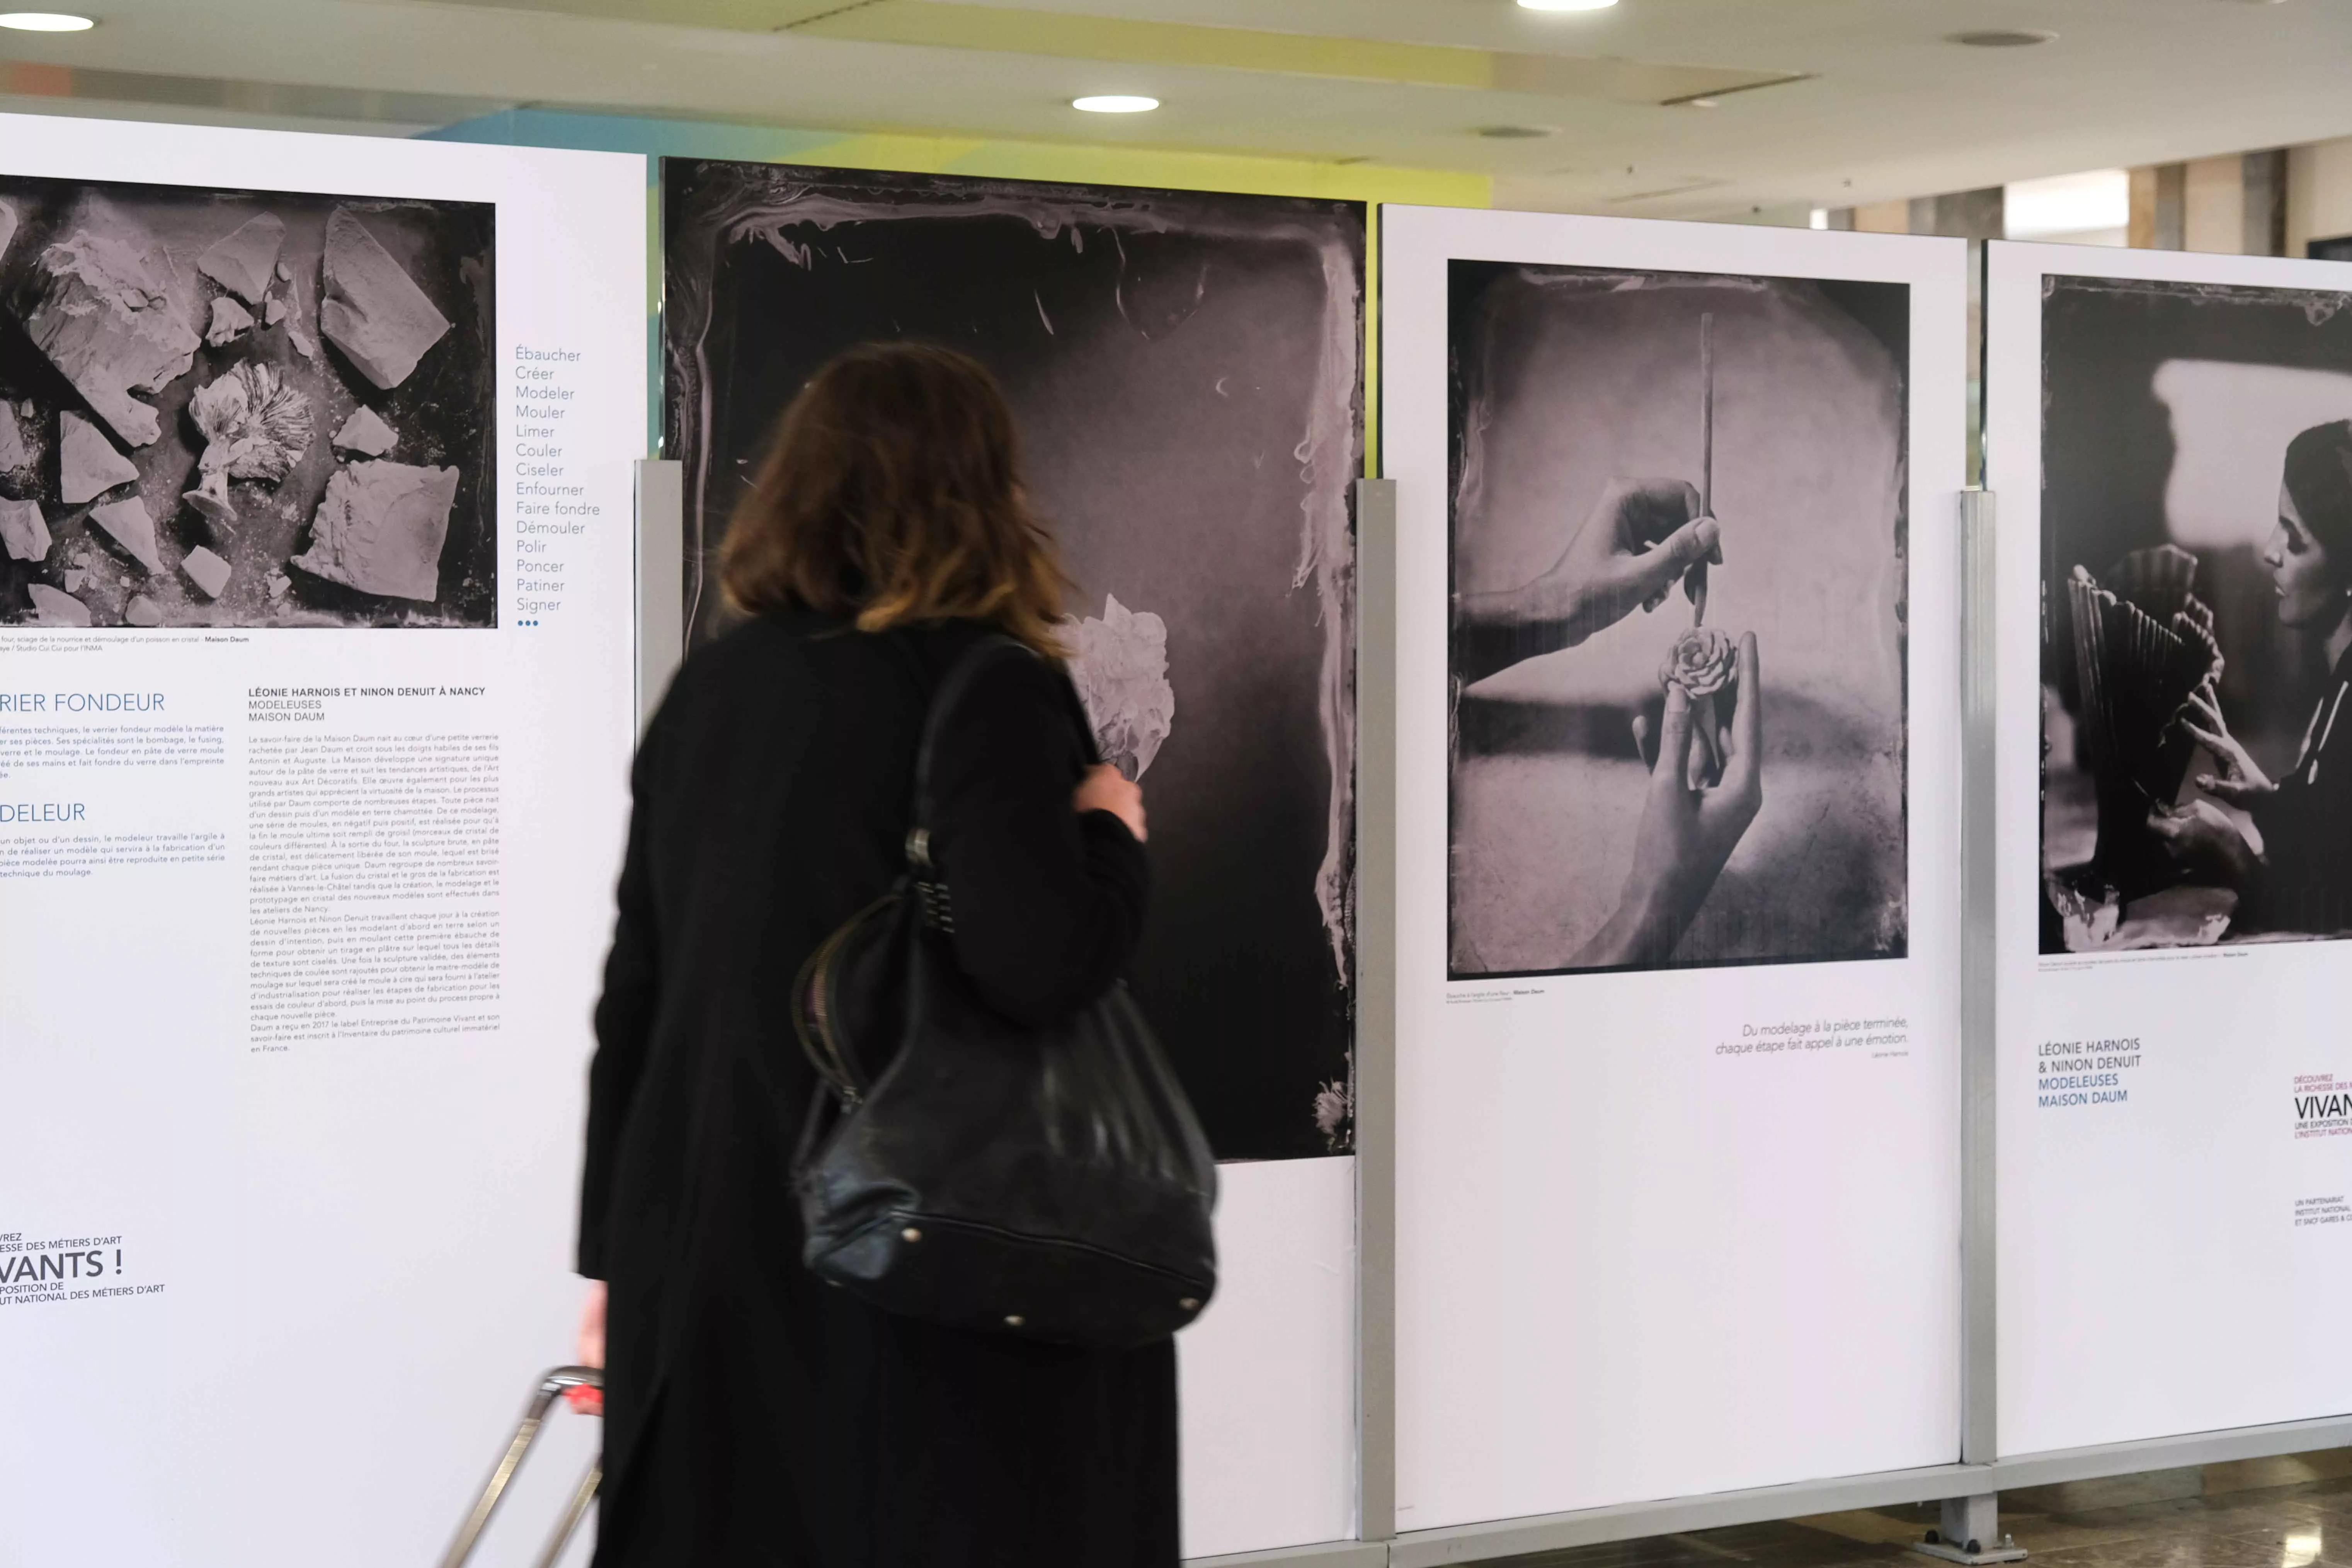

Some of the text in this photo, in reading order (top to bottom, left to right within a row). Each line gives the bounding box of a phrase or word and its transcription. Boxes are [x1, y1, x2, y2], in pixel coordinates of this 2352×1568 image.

[516, 343, 581, 362] Ébaucher
[516, 366, 554, 380] Créer
[516, 385, 574, 400] Modeler
[516, 405, 565, 419] Mouler
[517, 424, 555, 438] Limer
[516, 443, 562, 457] Couler
[516, 462, 564, 477] Ciseler
[517, 481, 584, 496] Enfourner
[517, 501, 600, 516] Faire fondre
[517, 520, 585, 535] Démouler
[517, 540, 547, 553] Polir
[517, 558, 564, 572] Poncer
[517, 578, 565, 592] Patiner
[517, 597, 561, 614] Signer
[249, 686, 485, 697] LÉONIE HARNOIS ET NINON DENUIT À NANCY
[56, 693, 164, 712] FONDEUR
[249, 700, 322, 709] MODELEUSES
[249, 712, 324, 722] MAISON DAUM
[34, 726, 80, 735] techniques,
[121, 725, 151, 733] fondeur
[26, 737, 53, 746] pièces.
[56, 737, 70, 745] Ses
[73, 736, 114, 746] spécialités
[146, 736, 186, 746] bombage,
[198, 735, 224, 745] fusing,
[45, 748, 82, 758] moulage.
[98, 747, 129, 755] fondeur
[144, 747, 162, 756] pâte
[0, 803, 85, 822] DELEUR
[14, 836, 35, 846] objet
[52, 835, 70, 843] d'un
[73, 835, 101, 843] dessin,
[115, 834, 153, 842] modeleur
[157, 833, 188, 841] travaille
[191, 833, 217, 842] l'argile
[23, 858, 57, 866] modelée
[127, 856, 168, 865] reproduite
[182, 854, 204, 863] petite
[0, 869, 40, 878] technique
[56, 868, 92, 877] moulage.
[1743, 1017, 1908, 1038] Du modelage à la pièce terminée,
[1715, 1033, 1908, 1056] chaque étape fait appel à une émotion.
[2039, 1038, 2140, 1057] LÉONIE HARNOIS
[2039, 1055, 2141, 1074] & NINON DENUIT
[2039, 1073, 2118, 1091] MODELEUSES
[2039, 1090, 2127, 1108] MAISON DAUM
[0, 1236, 122, 1253] ESSE DES MÉTIERS D'ART
[116, 1249, 121, 1275] !
[0, 1282, 63, 1294] POSITION DE
[0, 1284, 165, 1305] UT NATIONAL DES MÉTIERS D'ART
